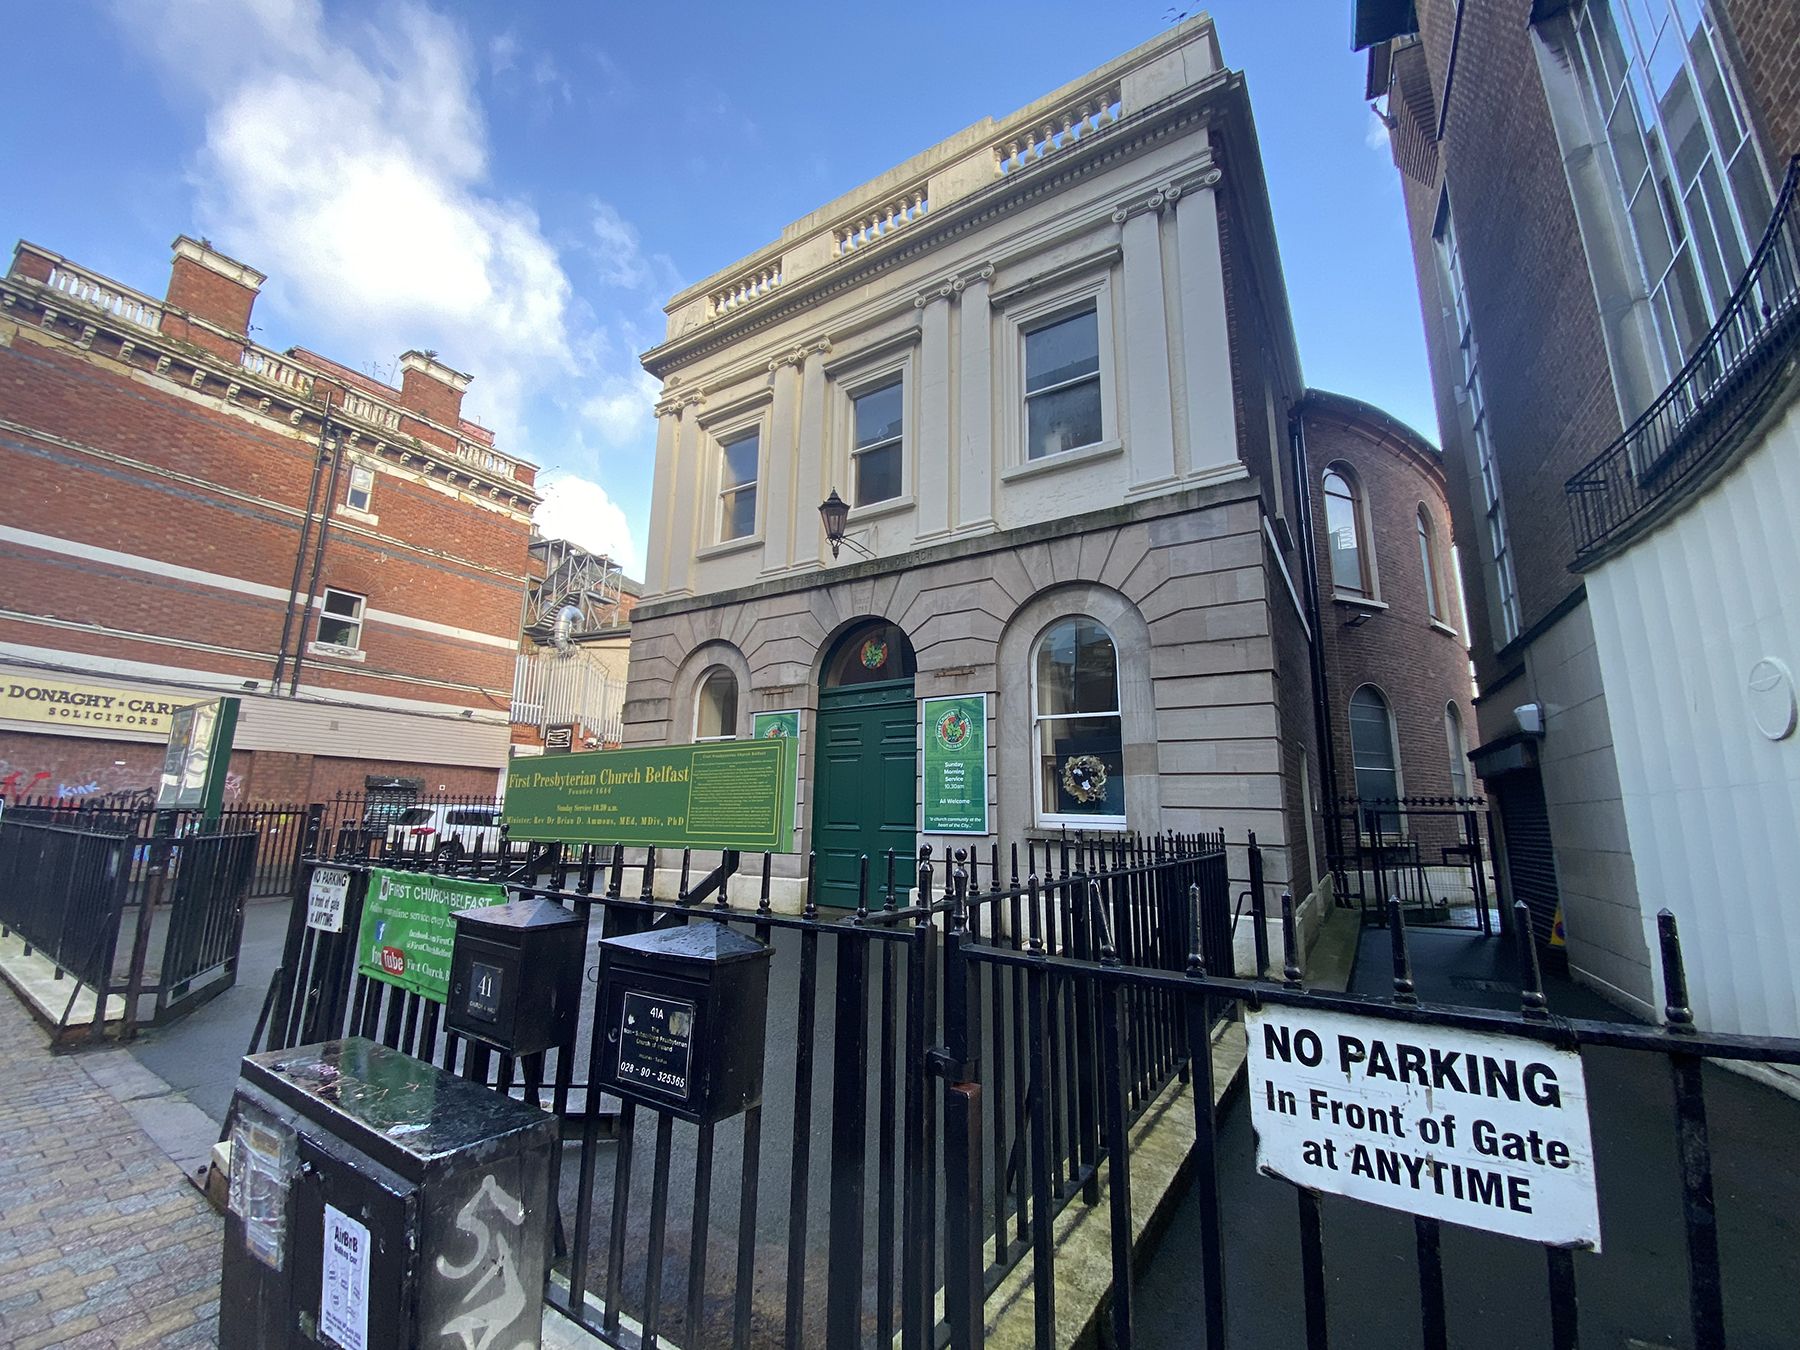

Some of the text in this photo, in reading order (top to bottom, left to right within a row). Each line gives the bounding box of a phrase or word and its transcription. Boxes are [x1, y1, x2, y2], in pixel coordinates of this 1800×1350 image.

[8, 685, 116, 709] DONAGHY
[49, 707, 159, 726] SOLICITORS
[508, 765, 690, 791] First Presbyterian Church Belfast
[667, 816, 685, 826] PhD
[322, 871, 348, 887] PARKING
[389, 883, 492, 910] FIRST CHURCH BELFAST
[478, 975, 492, 997] 41
[650, 1007, 664, 1020] 41A
[620, 1061, 635, 1073] 028
[640, 1066, 651, 1078] 90
[657, 1071, 685, 1088] 325365
[1263, 1023, 1561, 1109] NO PARKING
[1265, 1080, 1570, 1169] In Front of Gate
[1302, 1139, 1534, 1214] at ANYTIME
[335, 1226, 358, 1253] AirBnB
